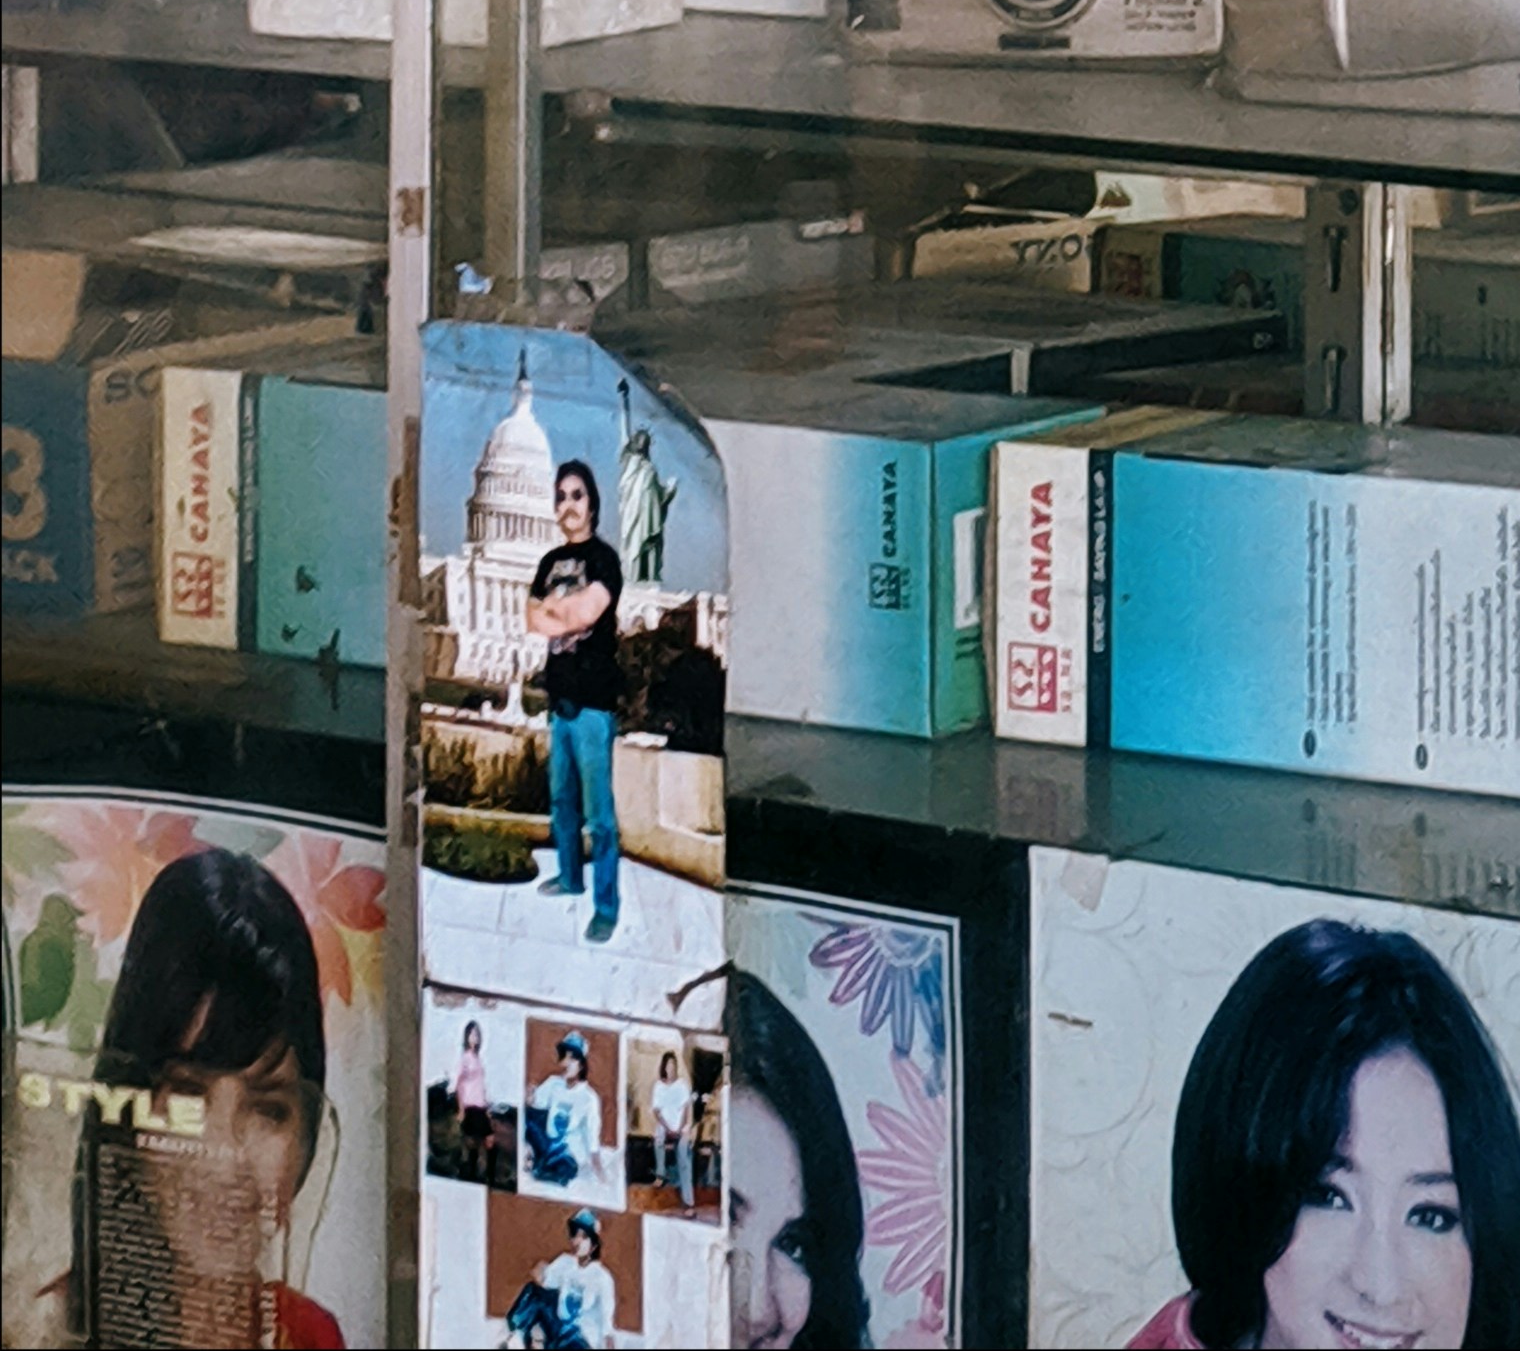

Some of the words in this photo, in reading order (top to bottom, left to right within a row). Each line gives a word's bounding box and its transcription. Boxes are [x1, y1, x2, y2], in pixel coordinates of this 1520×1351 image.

[189, 403, 213, 543] CAHAYA
[1030, 480, 1054, 634] CAHAYA
[17, 1071, 207, 1136] STYLE
